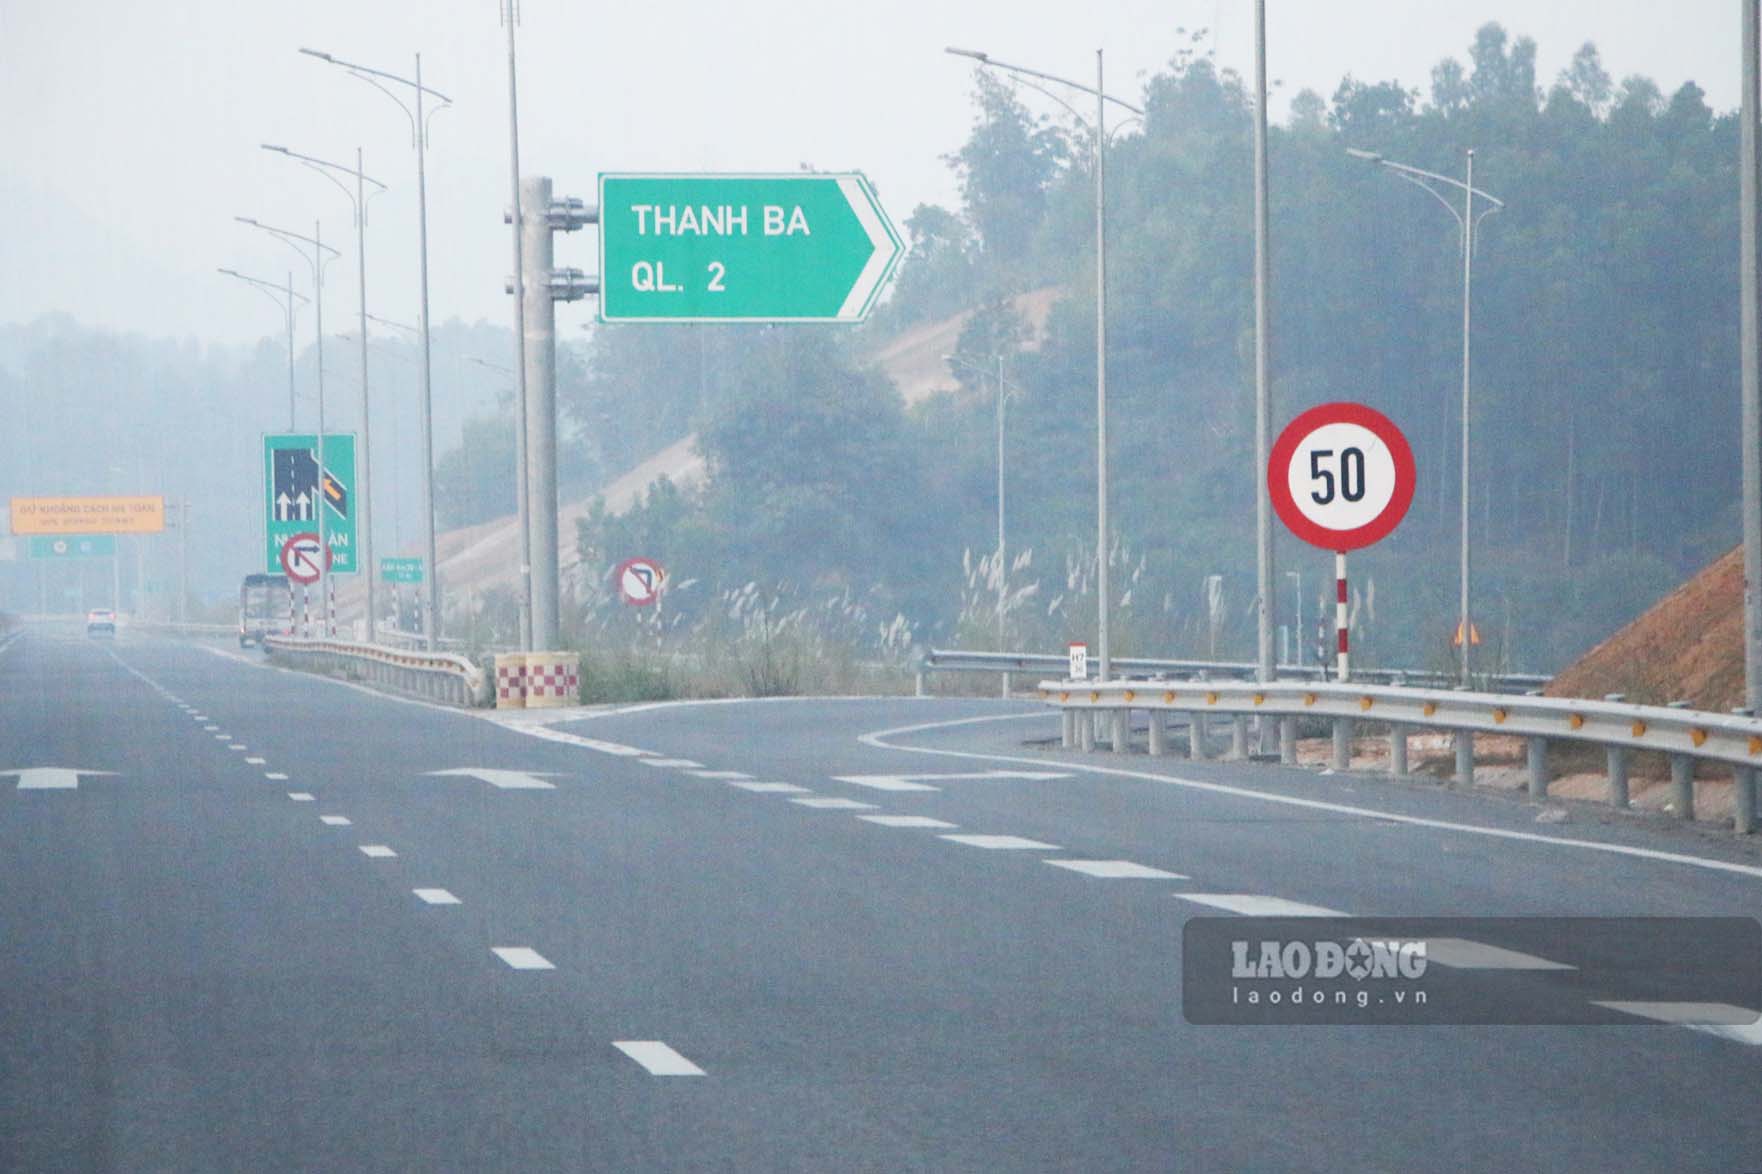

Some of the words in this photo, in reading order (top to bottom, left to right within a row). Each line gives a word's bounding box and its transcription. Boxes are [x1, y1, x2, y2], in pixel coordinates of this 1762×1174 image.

[631, 204, 748, 236] THANH
[763, 204, 811, 236] BA
[631, 260, 684, 292] QL.
[707, 260, 726, 292] 2
[1310, 446, 1366, 506] 50
[327, 528, 348, 546] ÀN
